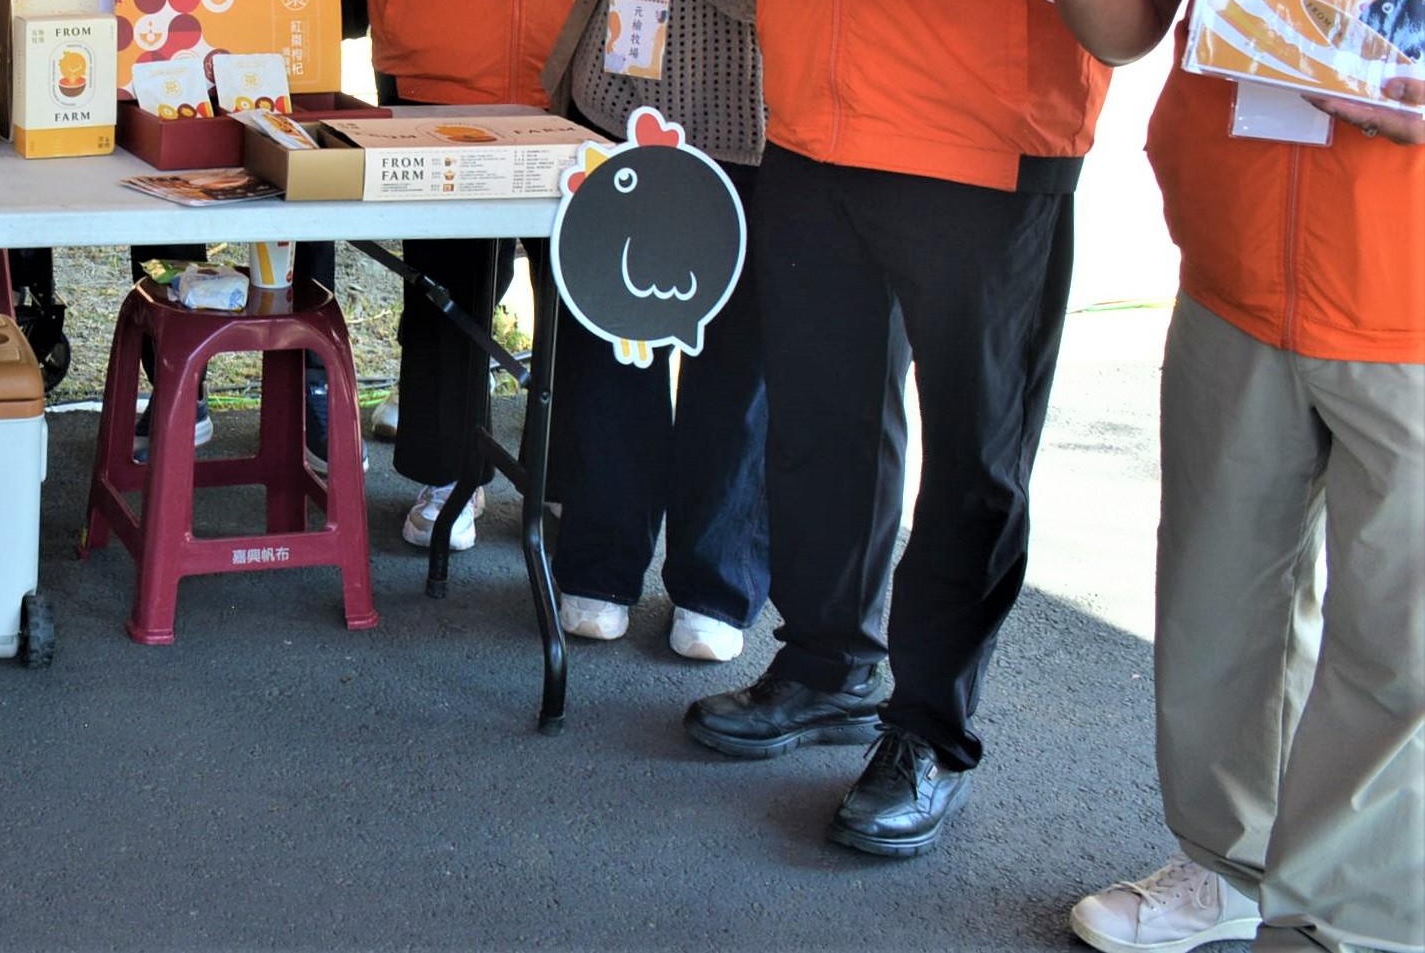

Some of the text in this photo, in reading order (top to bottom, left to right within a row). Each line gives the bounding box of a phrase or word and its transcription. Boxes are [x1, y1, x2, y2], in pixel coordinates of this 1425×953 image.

[55, 26, 92, 38] FROM
[629, 6, 644, 59] 元榆牧場
[54, 111, 91, 123] FARM
[382, 157, 425, 168] FROM
[382, 170, 425, 181] FARM
[232, 546, 290, 565] 嘉興帆布
